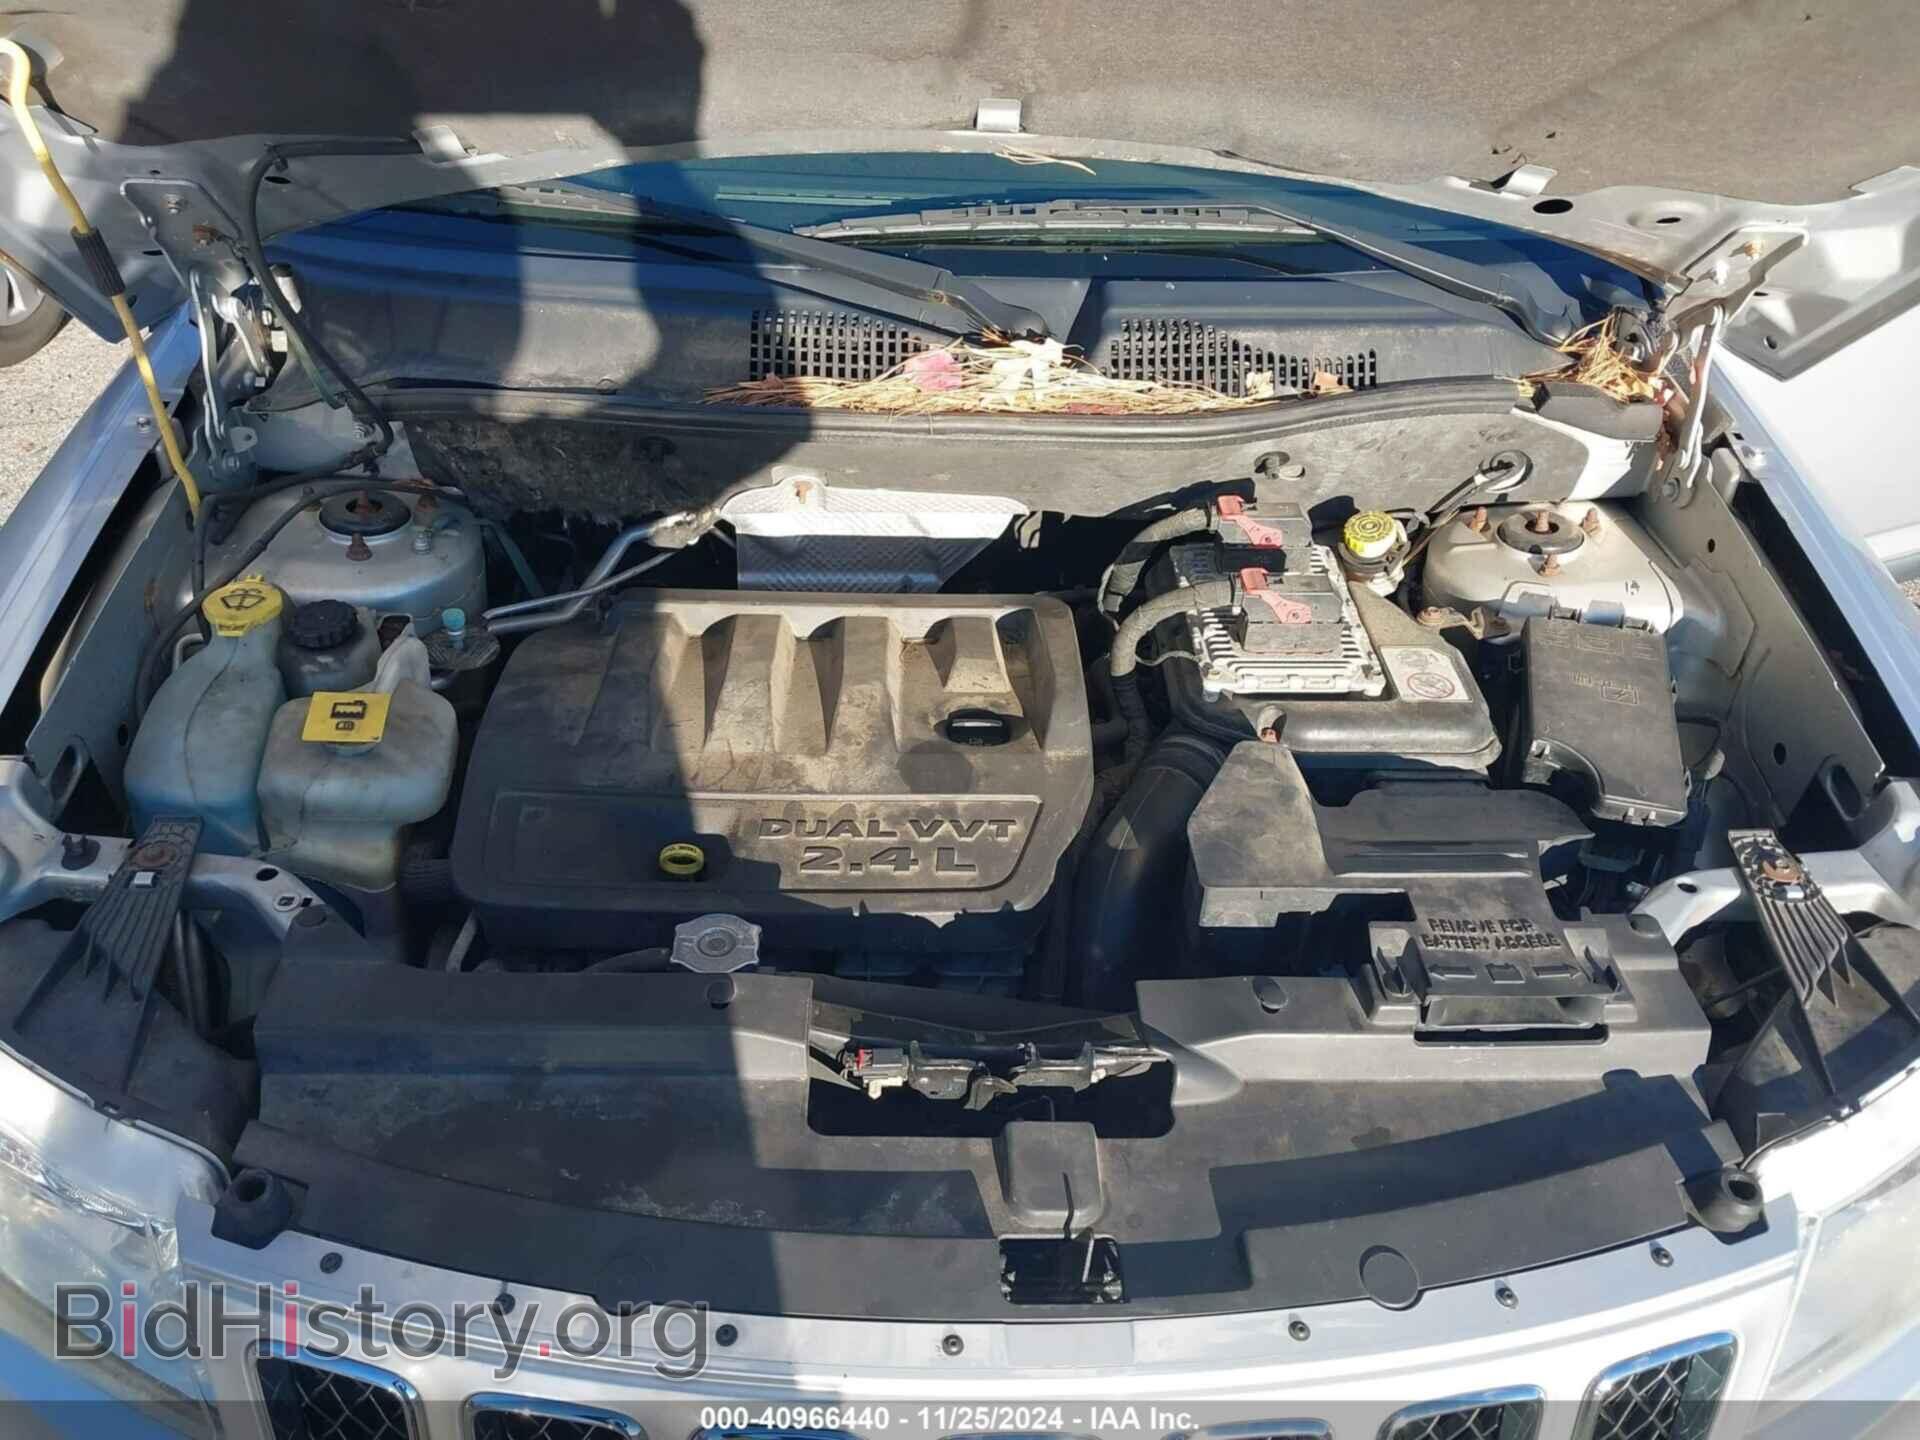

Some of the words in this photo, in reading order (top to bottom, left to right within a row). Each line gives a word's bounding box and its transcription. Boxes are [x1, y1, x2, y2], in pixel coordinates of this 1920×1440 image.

[758, 818, 898, 839] DUAL
[908, 818, 1017, 842] VVT
[1420, 933, 1490, 950] BATTERY
